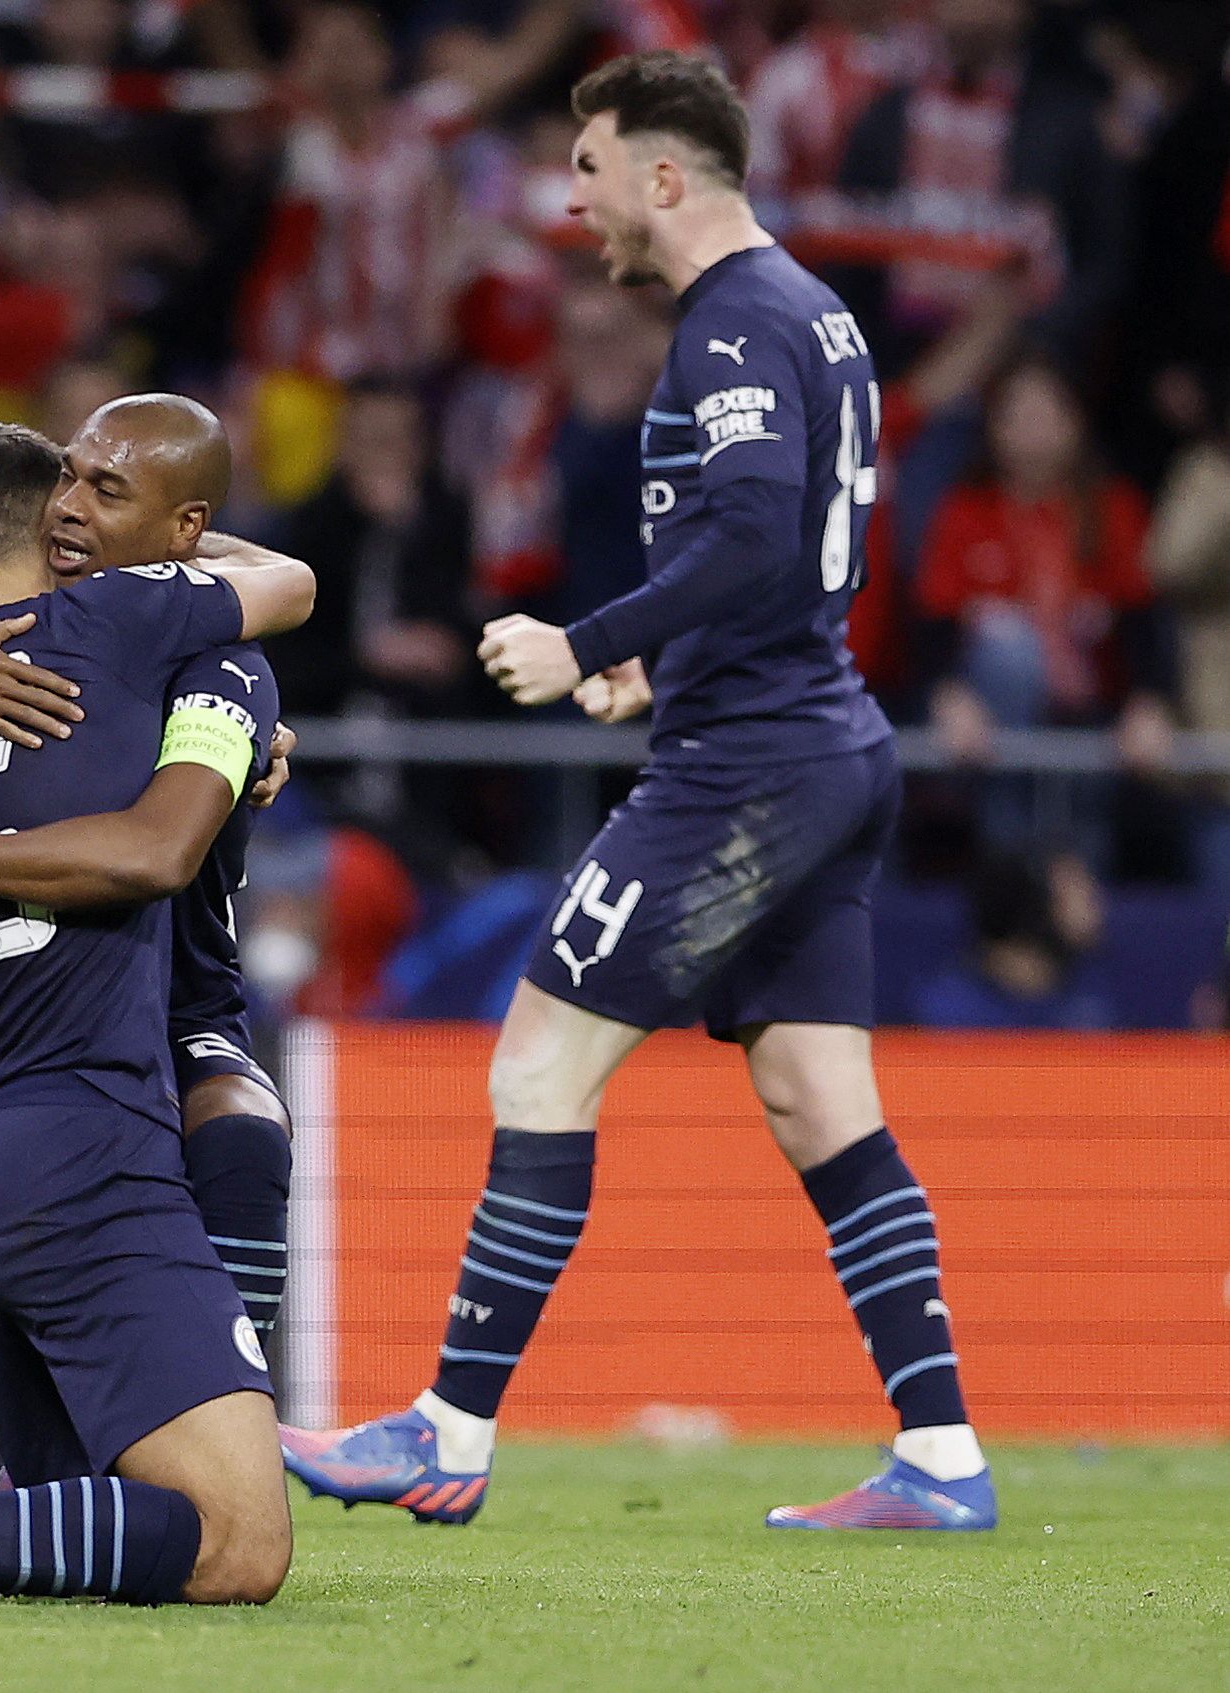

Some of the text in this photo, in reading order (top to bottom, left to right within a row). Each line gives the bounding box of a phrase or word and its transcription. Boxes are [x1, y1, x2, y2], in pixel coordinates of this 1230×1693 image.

[694, 386, 777, 428] NEXEN
[705, 411, 766, 444] TIRE
[171, 692, 258, 739] NEXEN
[551, 859, 644, 959] 14
